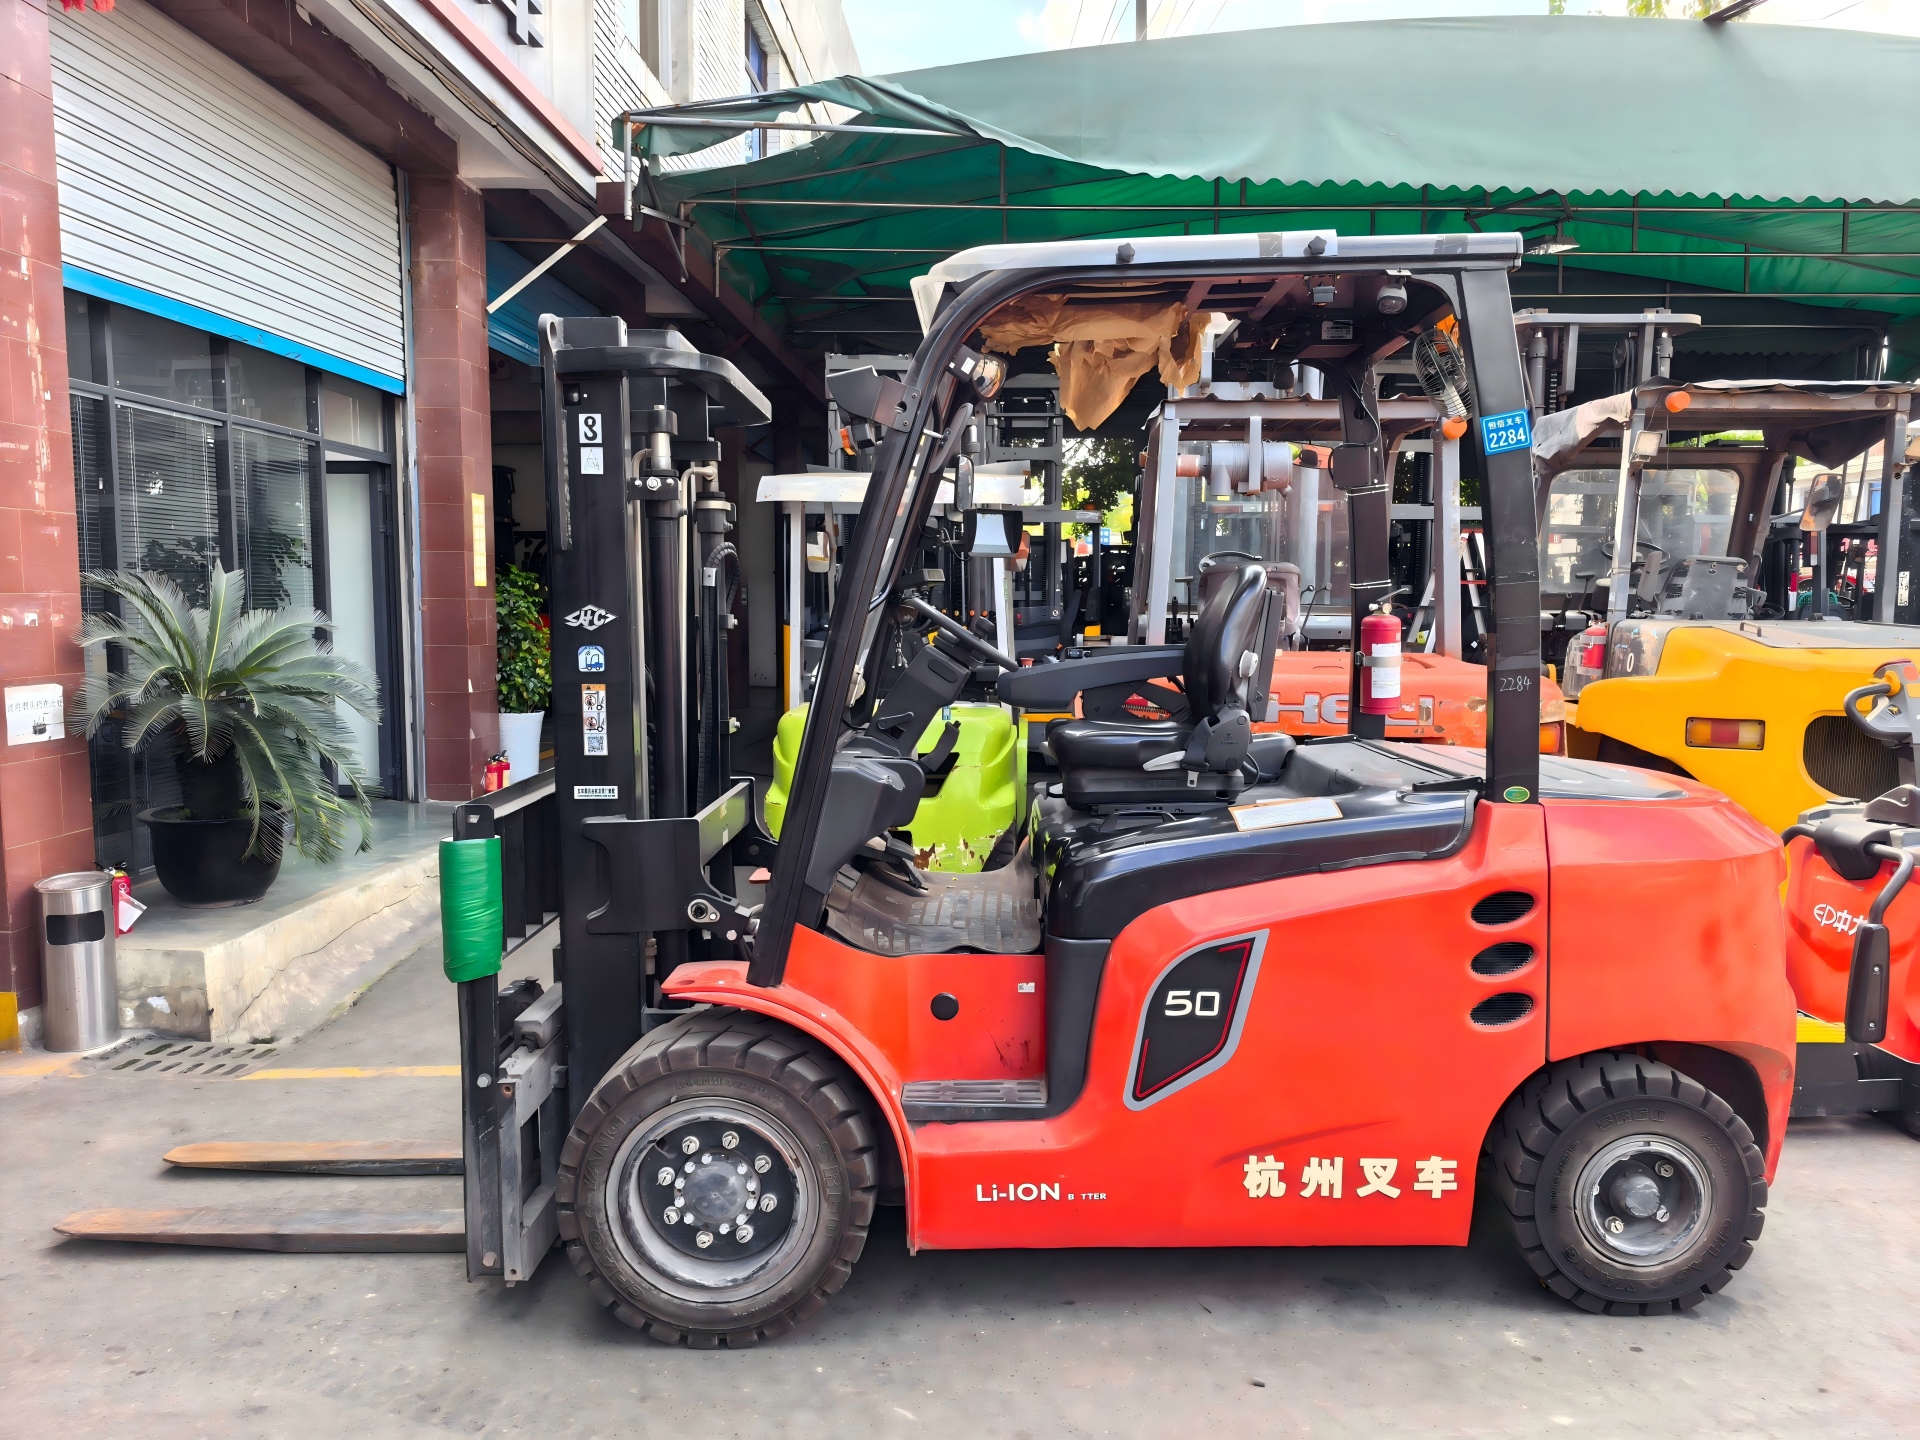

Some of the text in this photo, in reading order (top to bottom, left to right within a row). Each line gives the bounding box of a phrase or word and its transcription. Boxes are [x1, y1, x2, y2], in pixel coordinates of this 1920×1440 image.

[1489, 427, 1526, 448] 2284
[1500, 676, 1532, 691] 2284
[1165, 990, 1220, 1016] 50
[1243, 1154, 1458, 1199] 杭州叉车
[976, 1183, 1060, 1201] Li-ION
